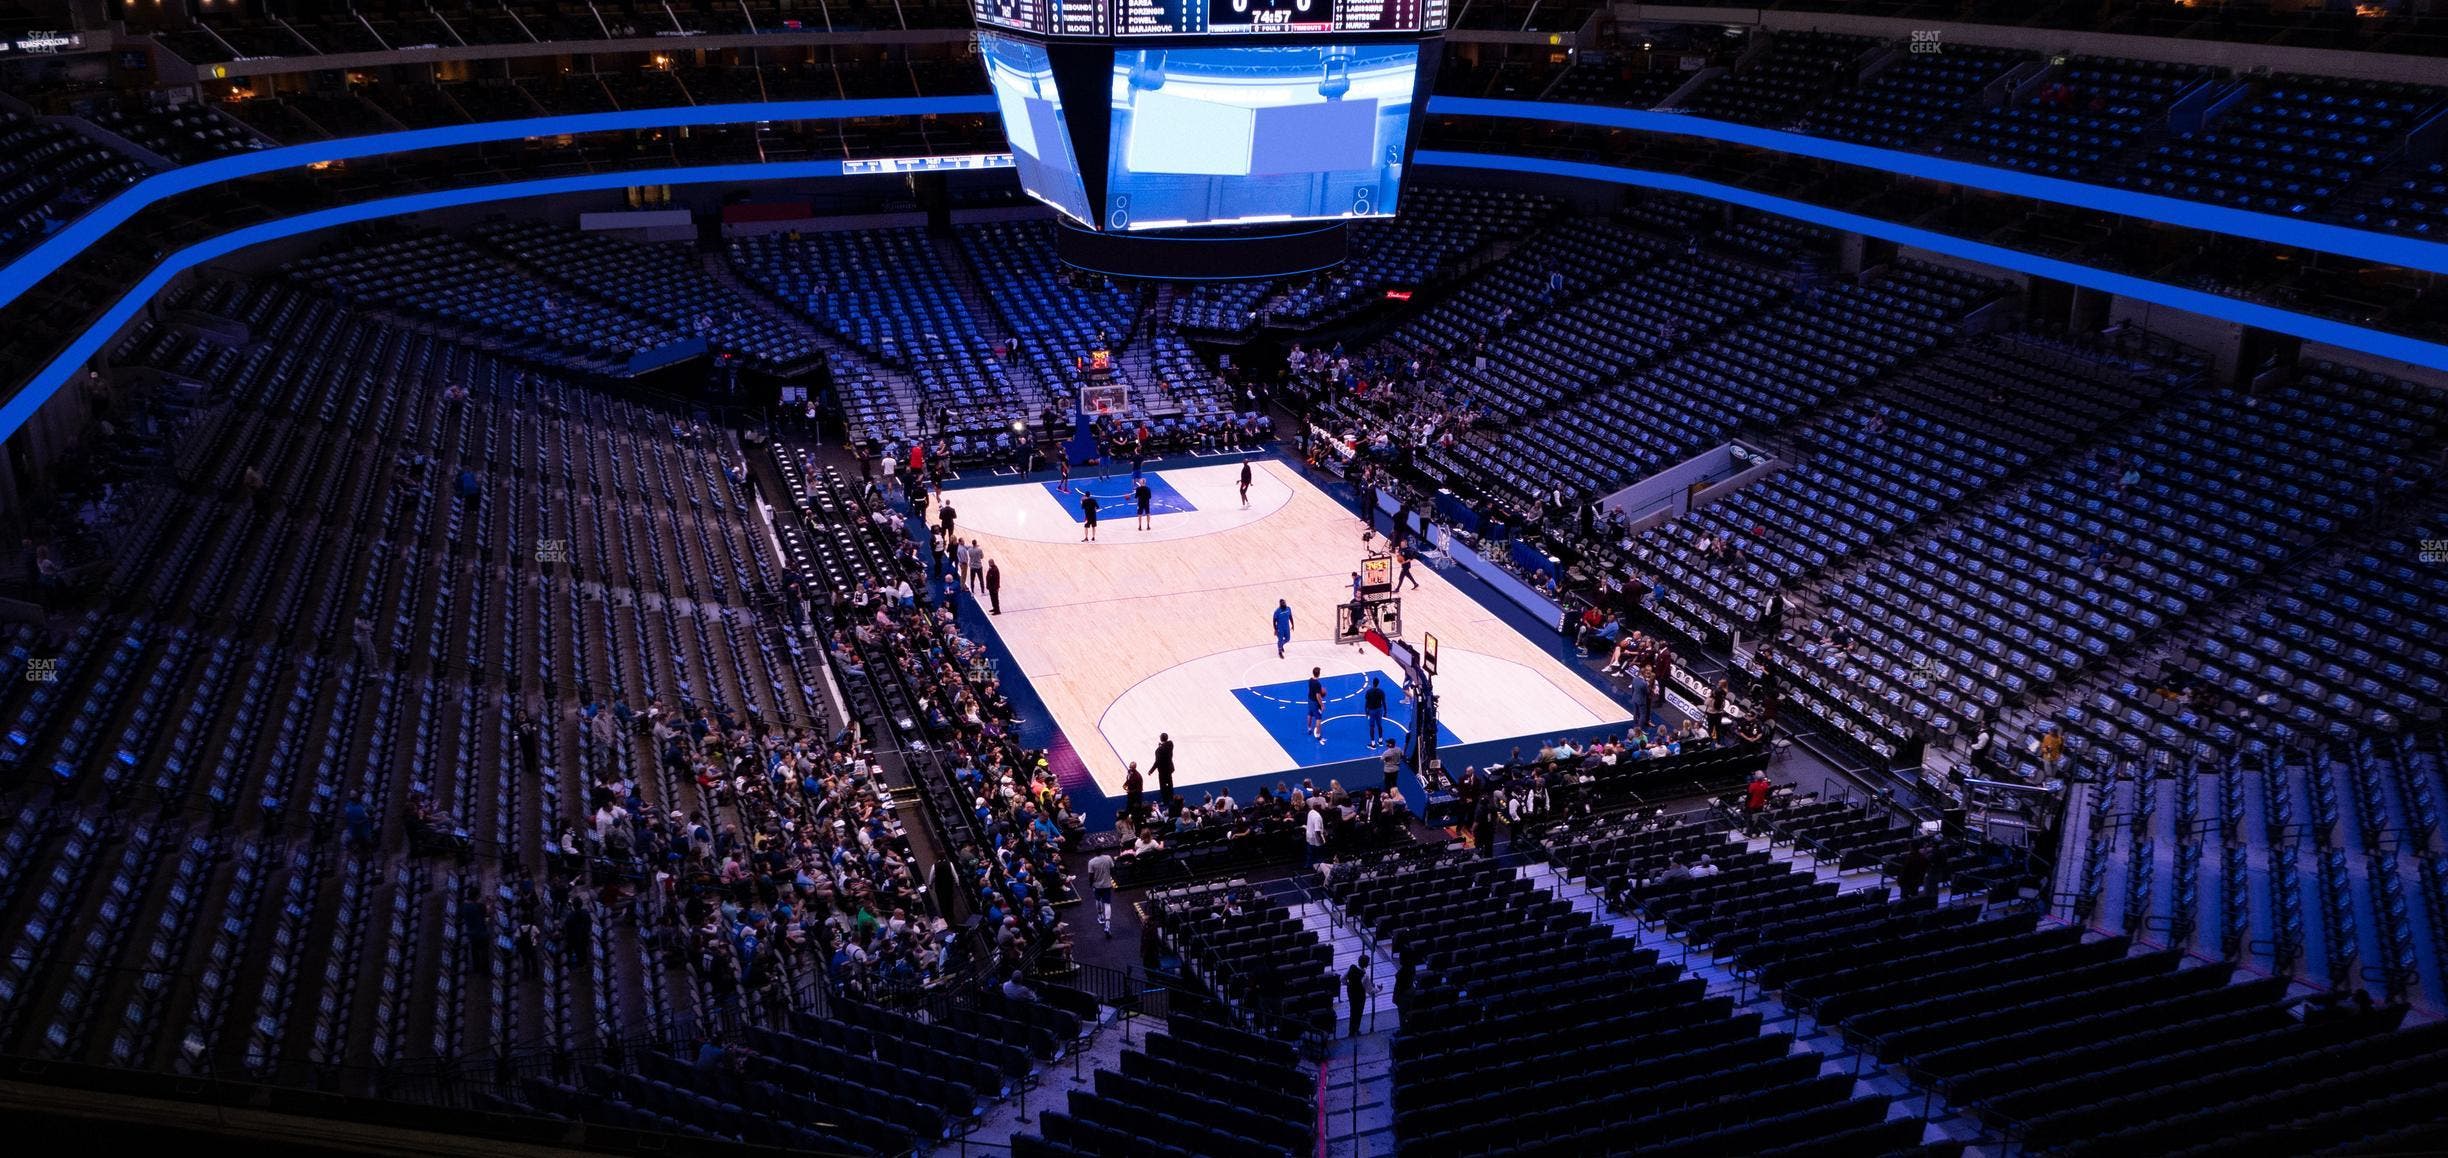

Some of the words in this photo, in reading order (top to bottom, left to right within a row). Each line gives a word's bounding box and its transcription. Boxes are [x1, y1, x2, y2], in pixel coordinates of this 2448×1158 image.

[1128, 16, 1158, 24] POWELL
[1252, 10, 1292, 23] 74:57
[1067, 24, 1090, 32] BLOCKS
[1128, 25, 1173, 33] MARJANOVIC
[1094, 358, 1107, 369] 24
[1667, 693, 1689, 711] GEICO
